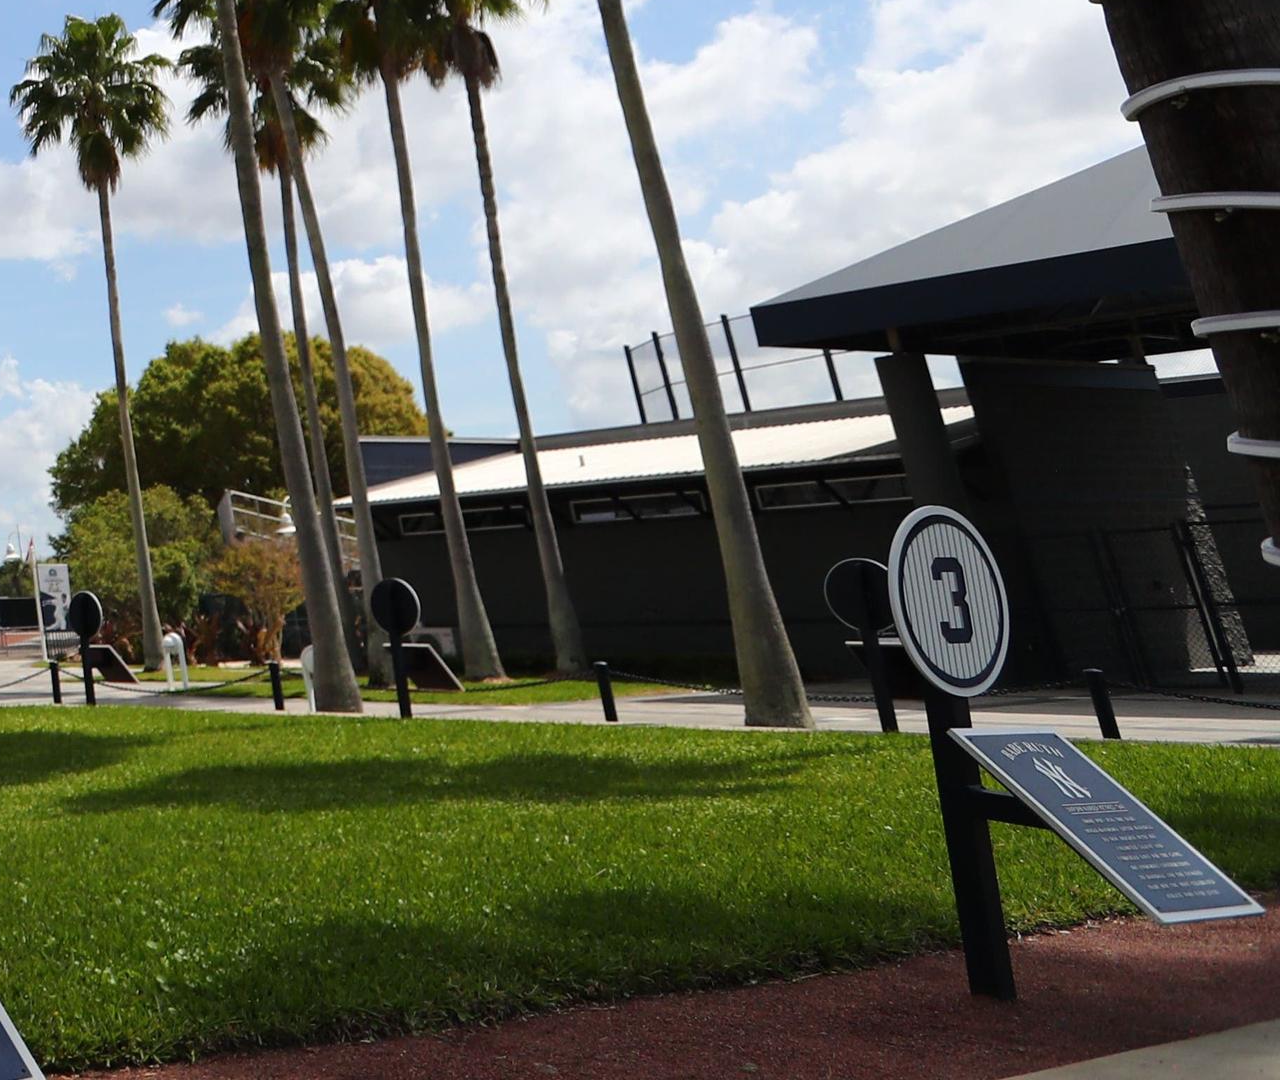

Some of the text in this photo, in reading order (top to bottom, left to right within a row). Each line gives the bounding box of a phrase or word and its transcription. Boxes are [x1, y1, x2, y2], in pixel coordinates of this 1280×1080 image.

[930, 556, 974, 645] 3
[1000, 741, 1065, 761] BABE RUTH
